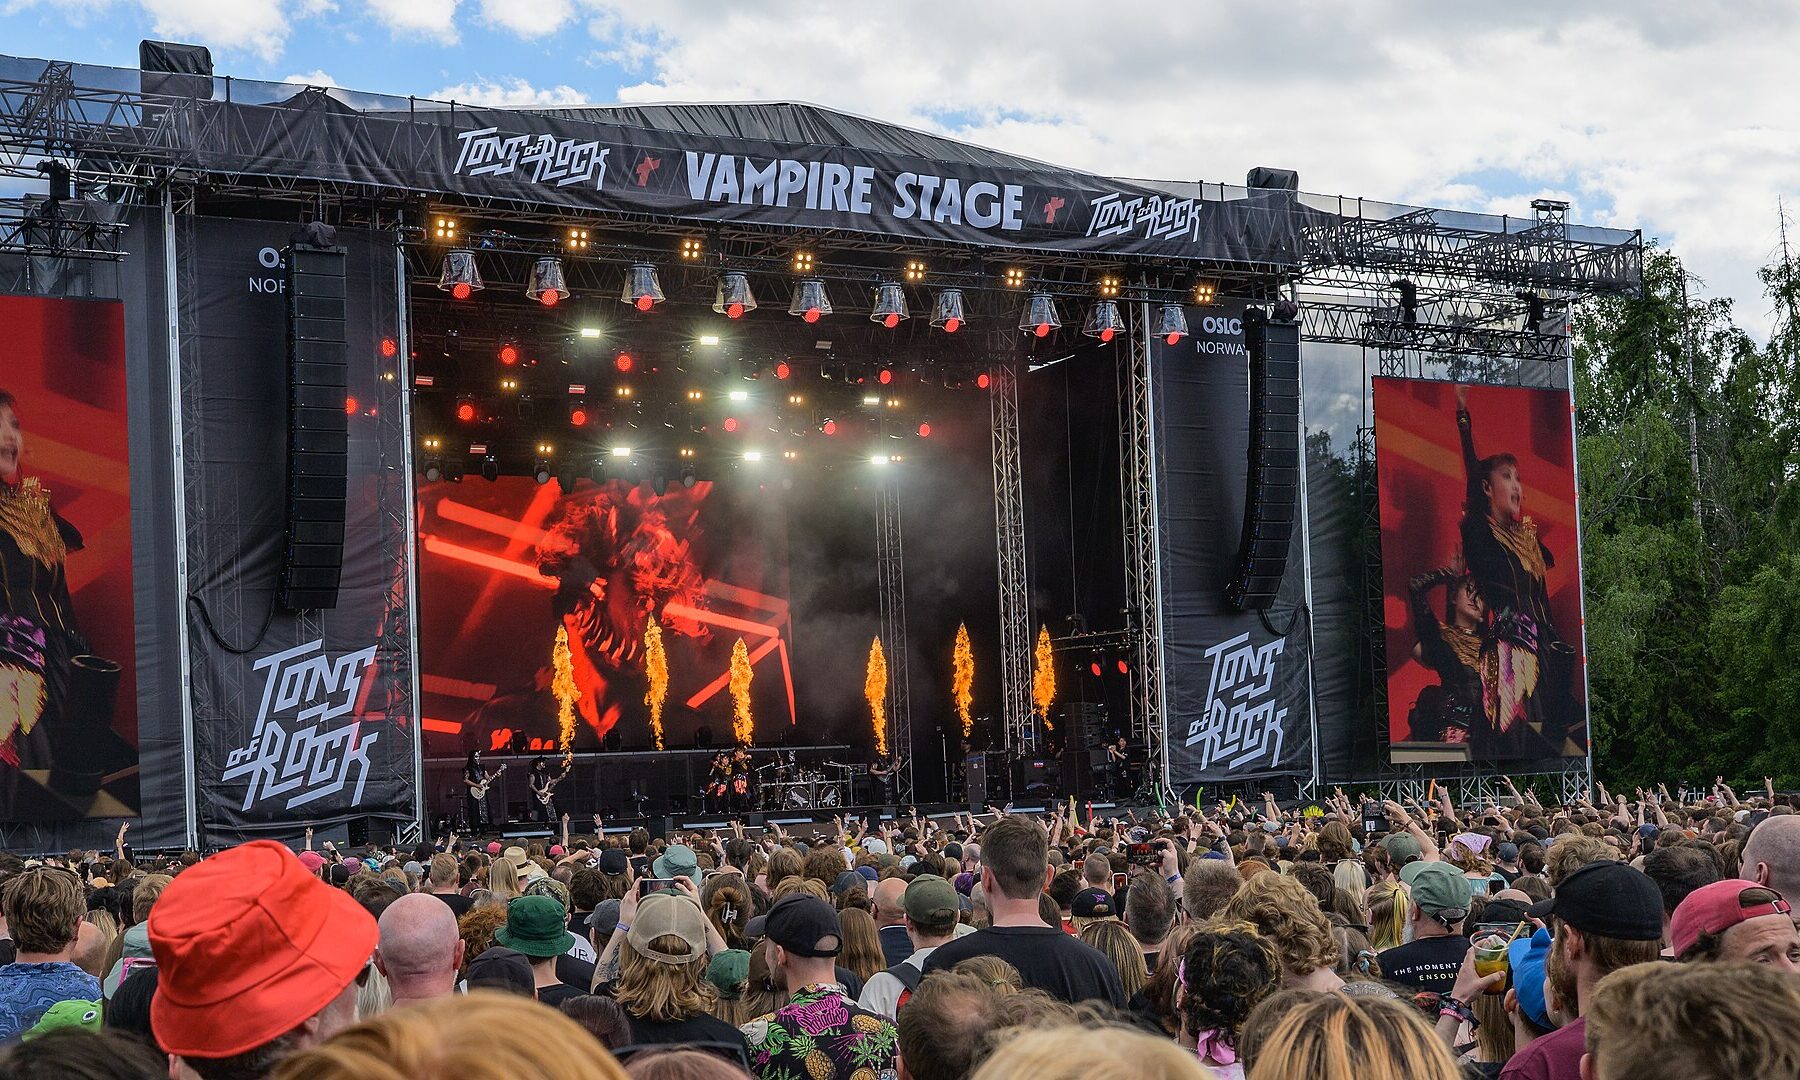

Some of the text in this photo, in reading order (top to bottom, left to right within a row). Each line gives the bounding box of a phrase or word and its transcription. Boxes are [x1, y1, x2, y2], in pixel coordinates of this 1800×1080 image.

[453, 127, 530, 176] TONS
[520, 134, 610, 191] ROCK
[685, 151, 1023, 231] VAMPIRE STAGE
[1085, 192, 1143, 237] TONS
[1136, 195, 1202, 242] ROCK
[252, 639, 378, 738] TONS
[1204, 631, 1286, 712] TONS
[222, 720, 379, 811] ROCK
[1185, 698, 1288, 771] ROCK
[1394, 967, 1412, 976] THE
[1415, 962, 1457, 972] MOMENT
